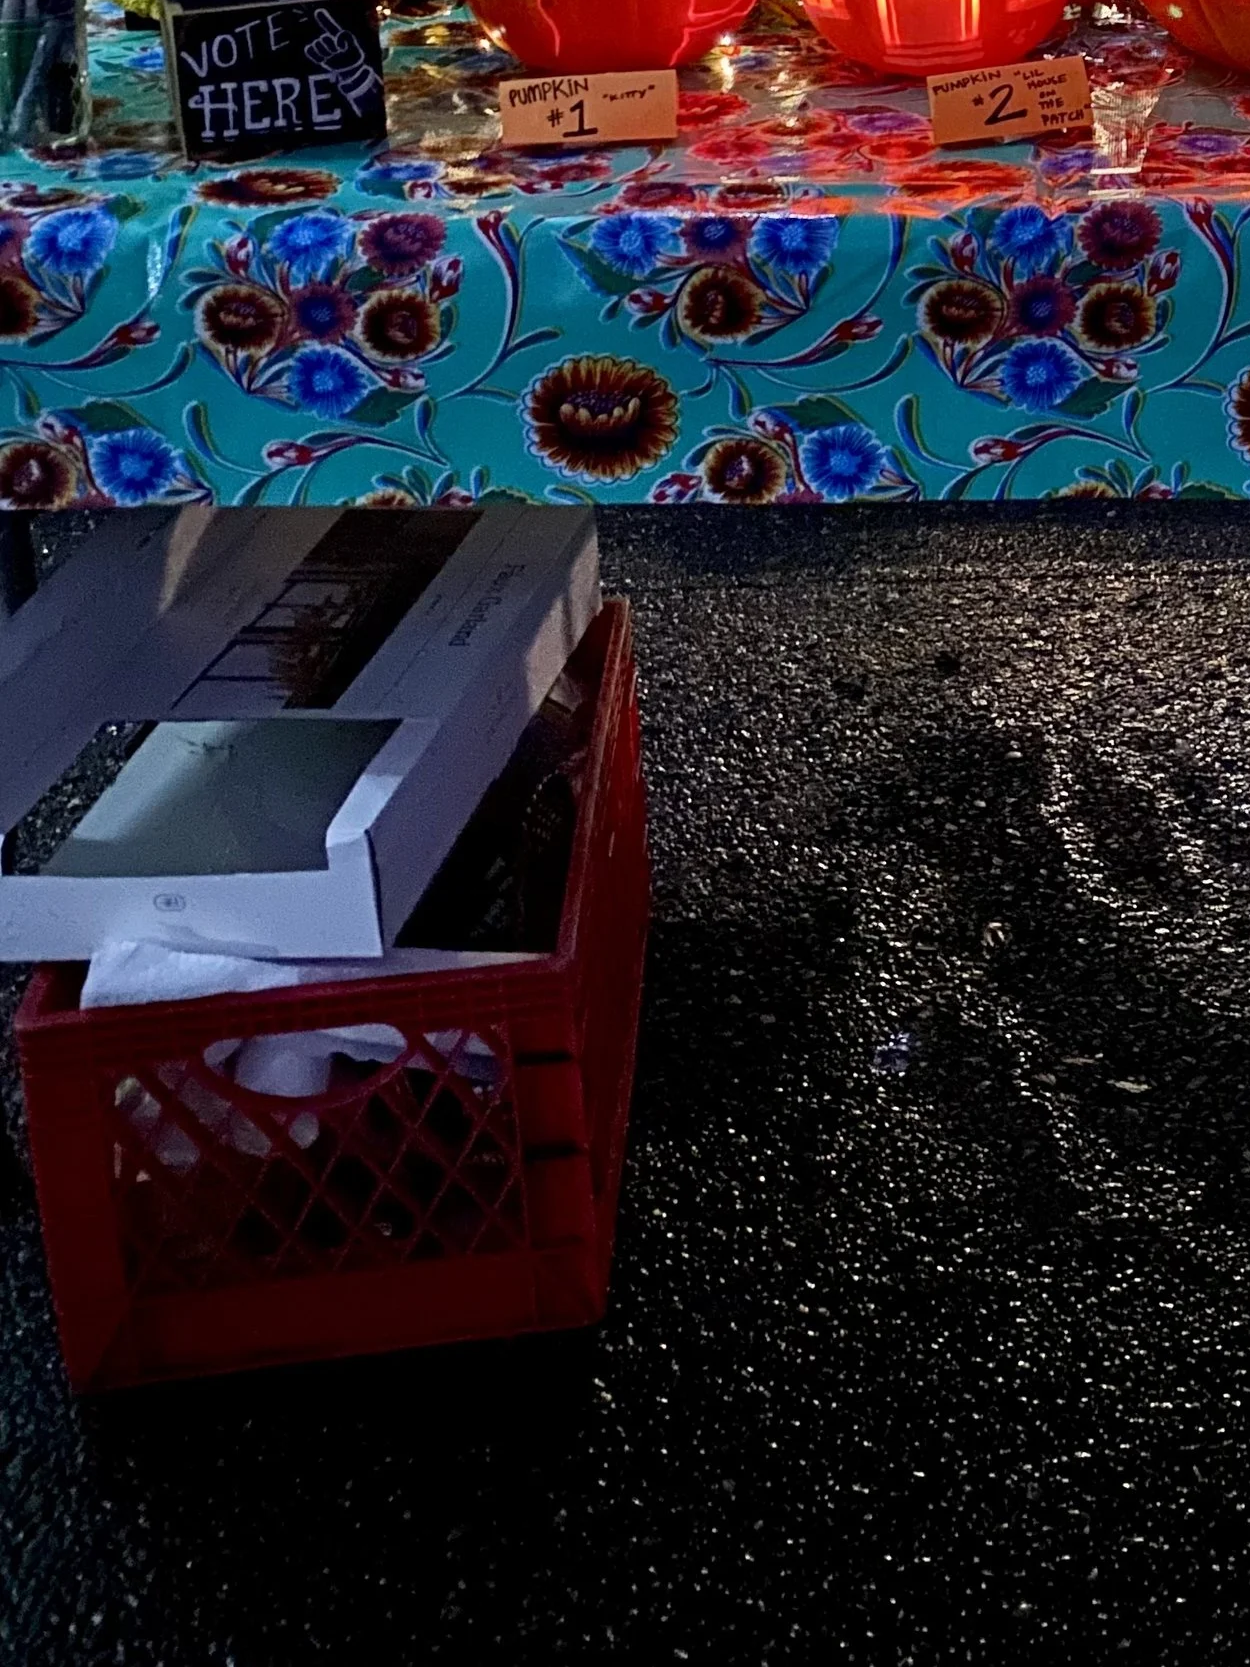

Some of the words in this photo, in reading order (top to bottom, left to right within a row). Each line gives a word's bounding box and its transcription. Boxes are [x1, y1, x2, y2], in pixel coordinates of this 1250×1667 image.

[180, 11, 290, 78] VOTE
[1027, 73, 1068, 90] HOUSE
[1039, 89, 1057, 99] ON
[188, 73, 342, 139] HERE
[546, 99, 599, 138] #1
[971, 83, 1028, 126] #2
[1038, 97, 1064, 110] THE
